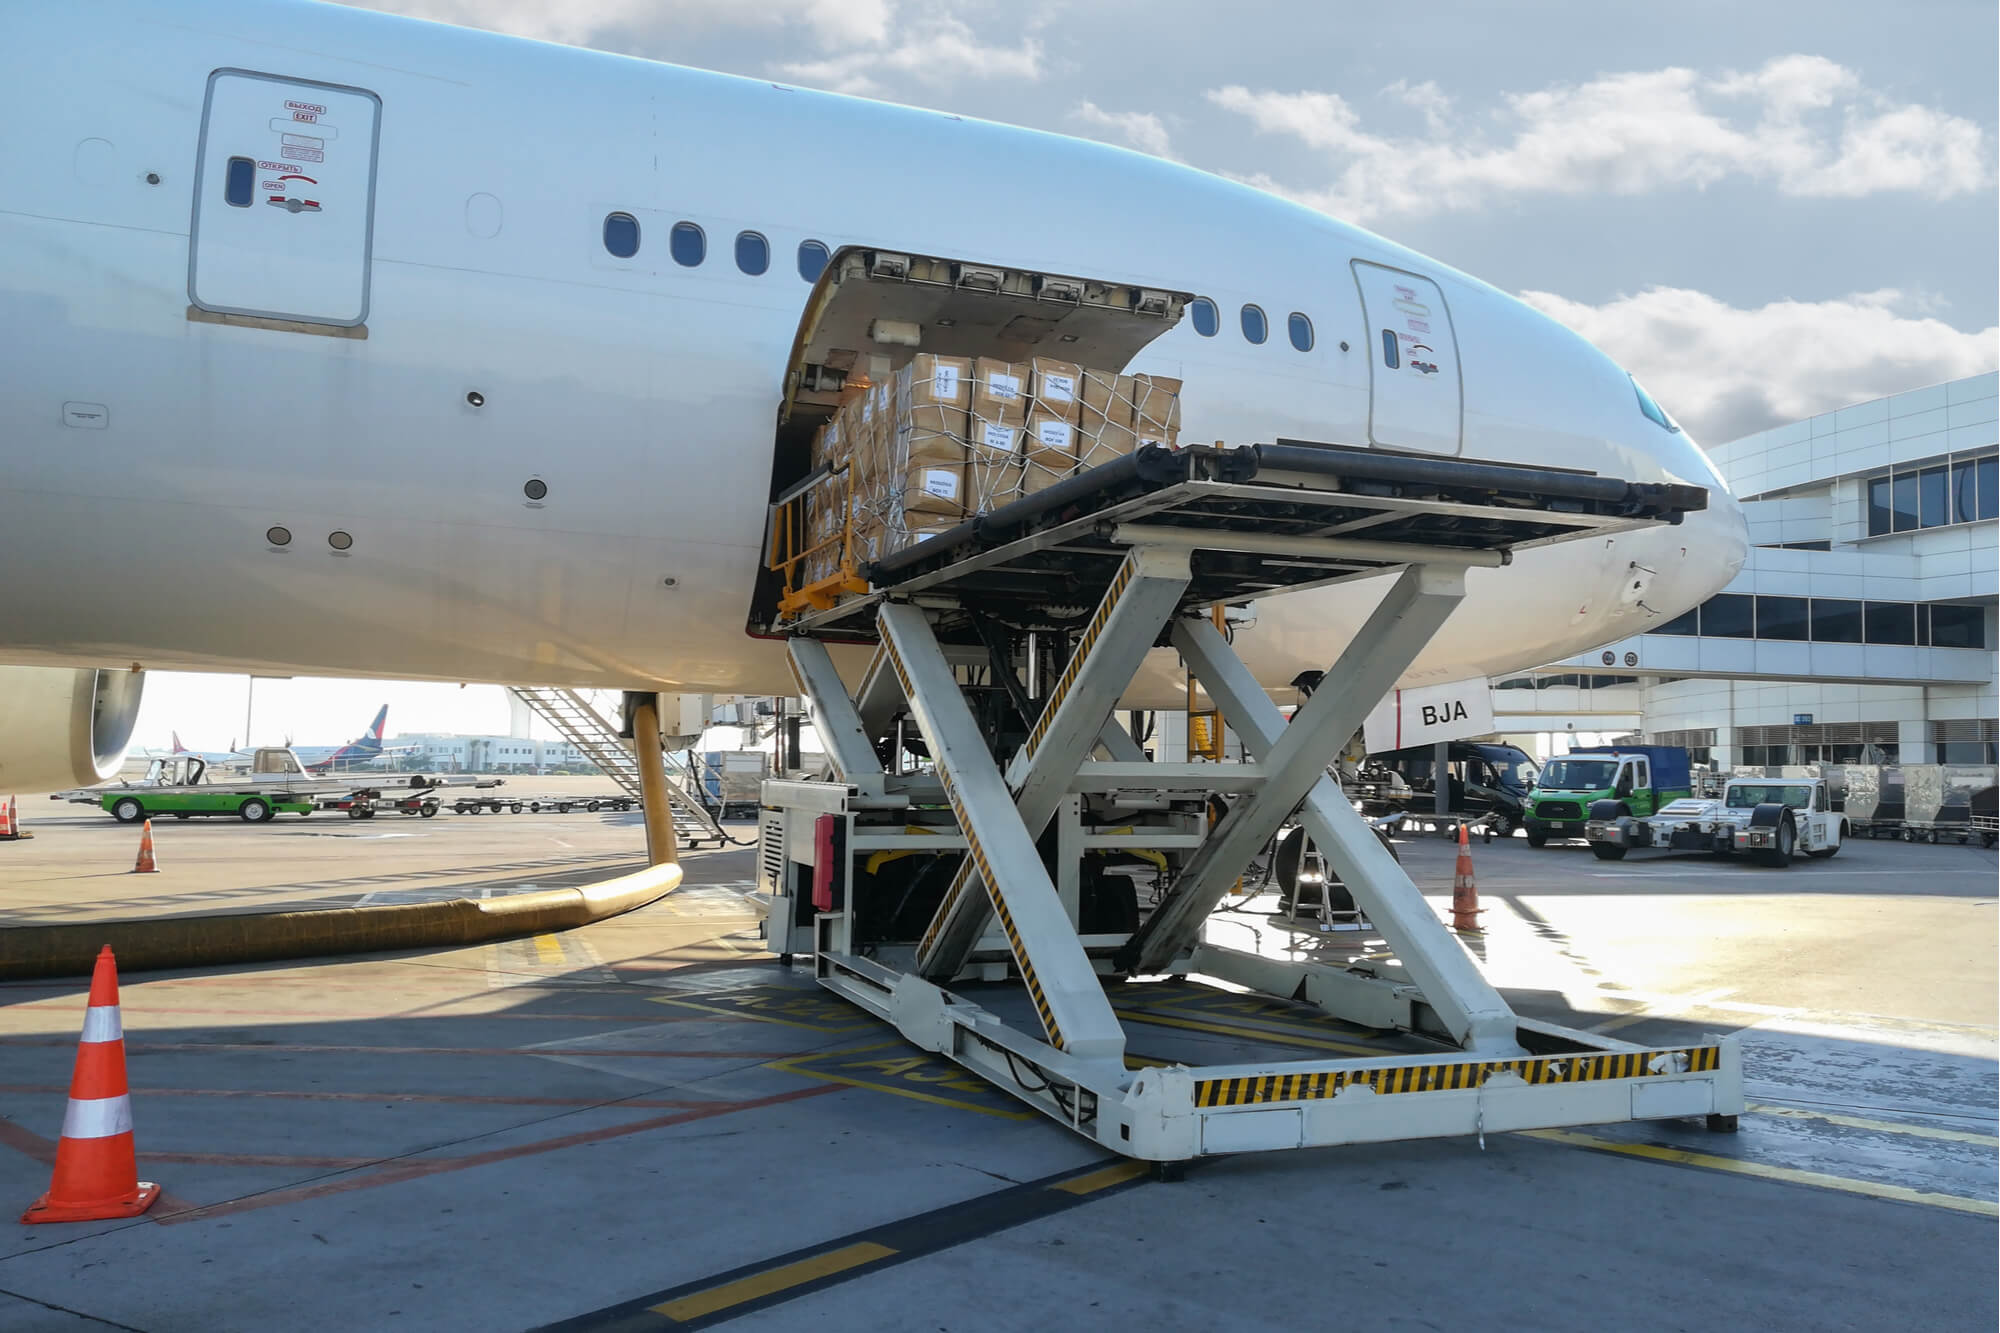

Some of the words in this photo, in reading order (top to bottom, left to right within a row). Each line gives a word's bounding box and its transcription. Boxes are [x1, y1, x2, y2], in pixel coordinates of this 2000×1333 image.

[288, 102, 322, 113] ВЫХОД
[295, 113, 314, 121] EXIT
[261, 162, 298, 172] ОТКРЫТЬ
[1421, 700, 1468, 726] BJA
